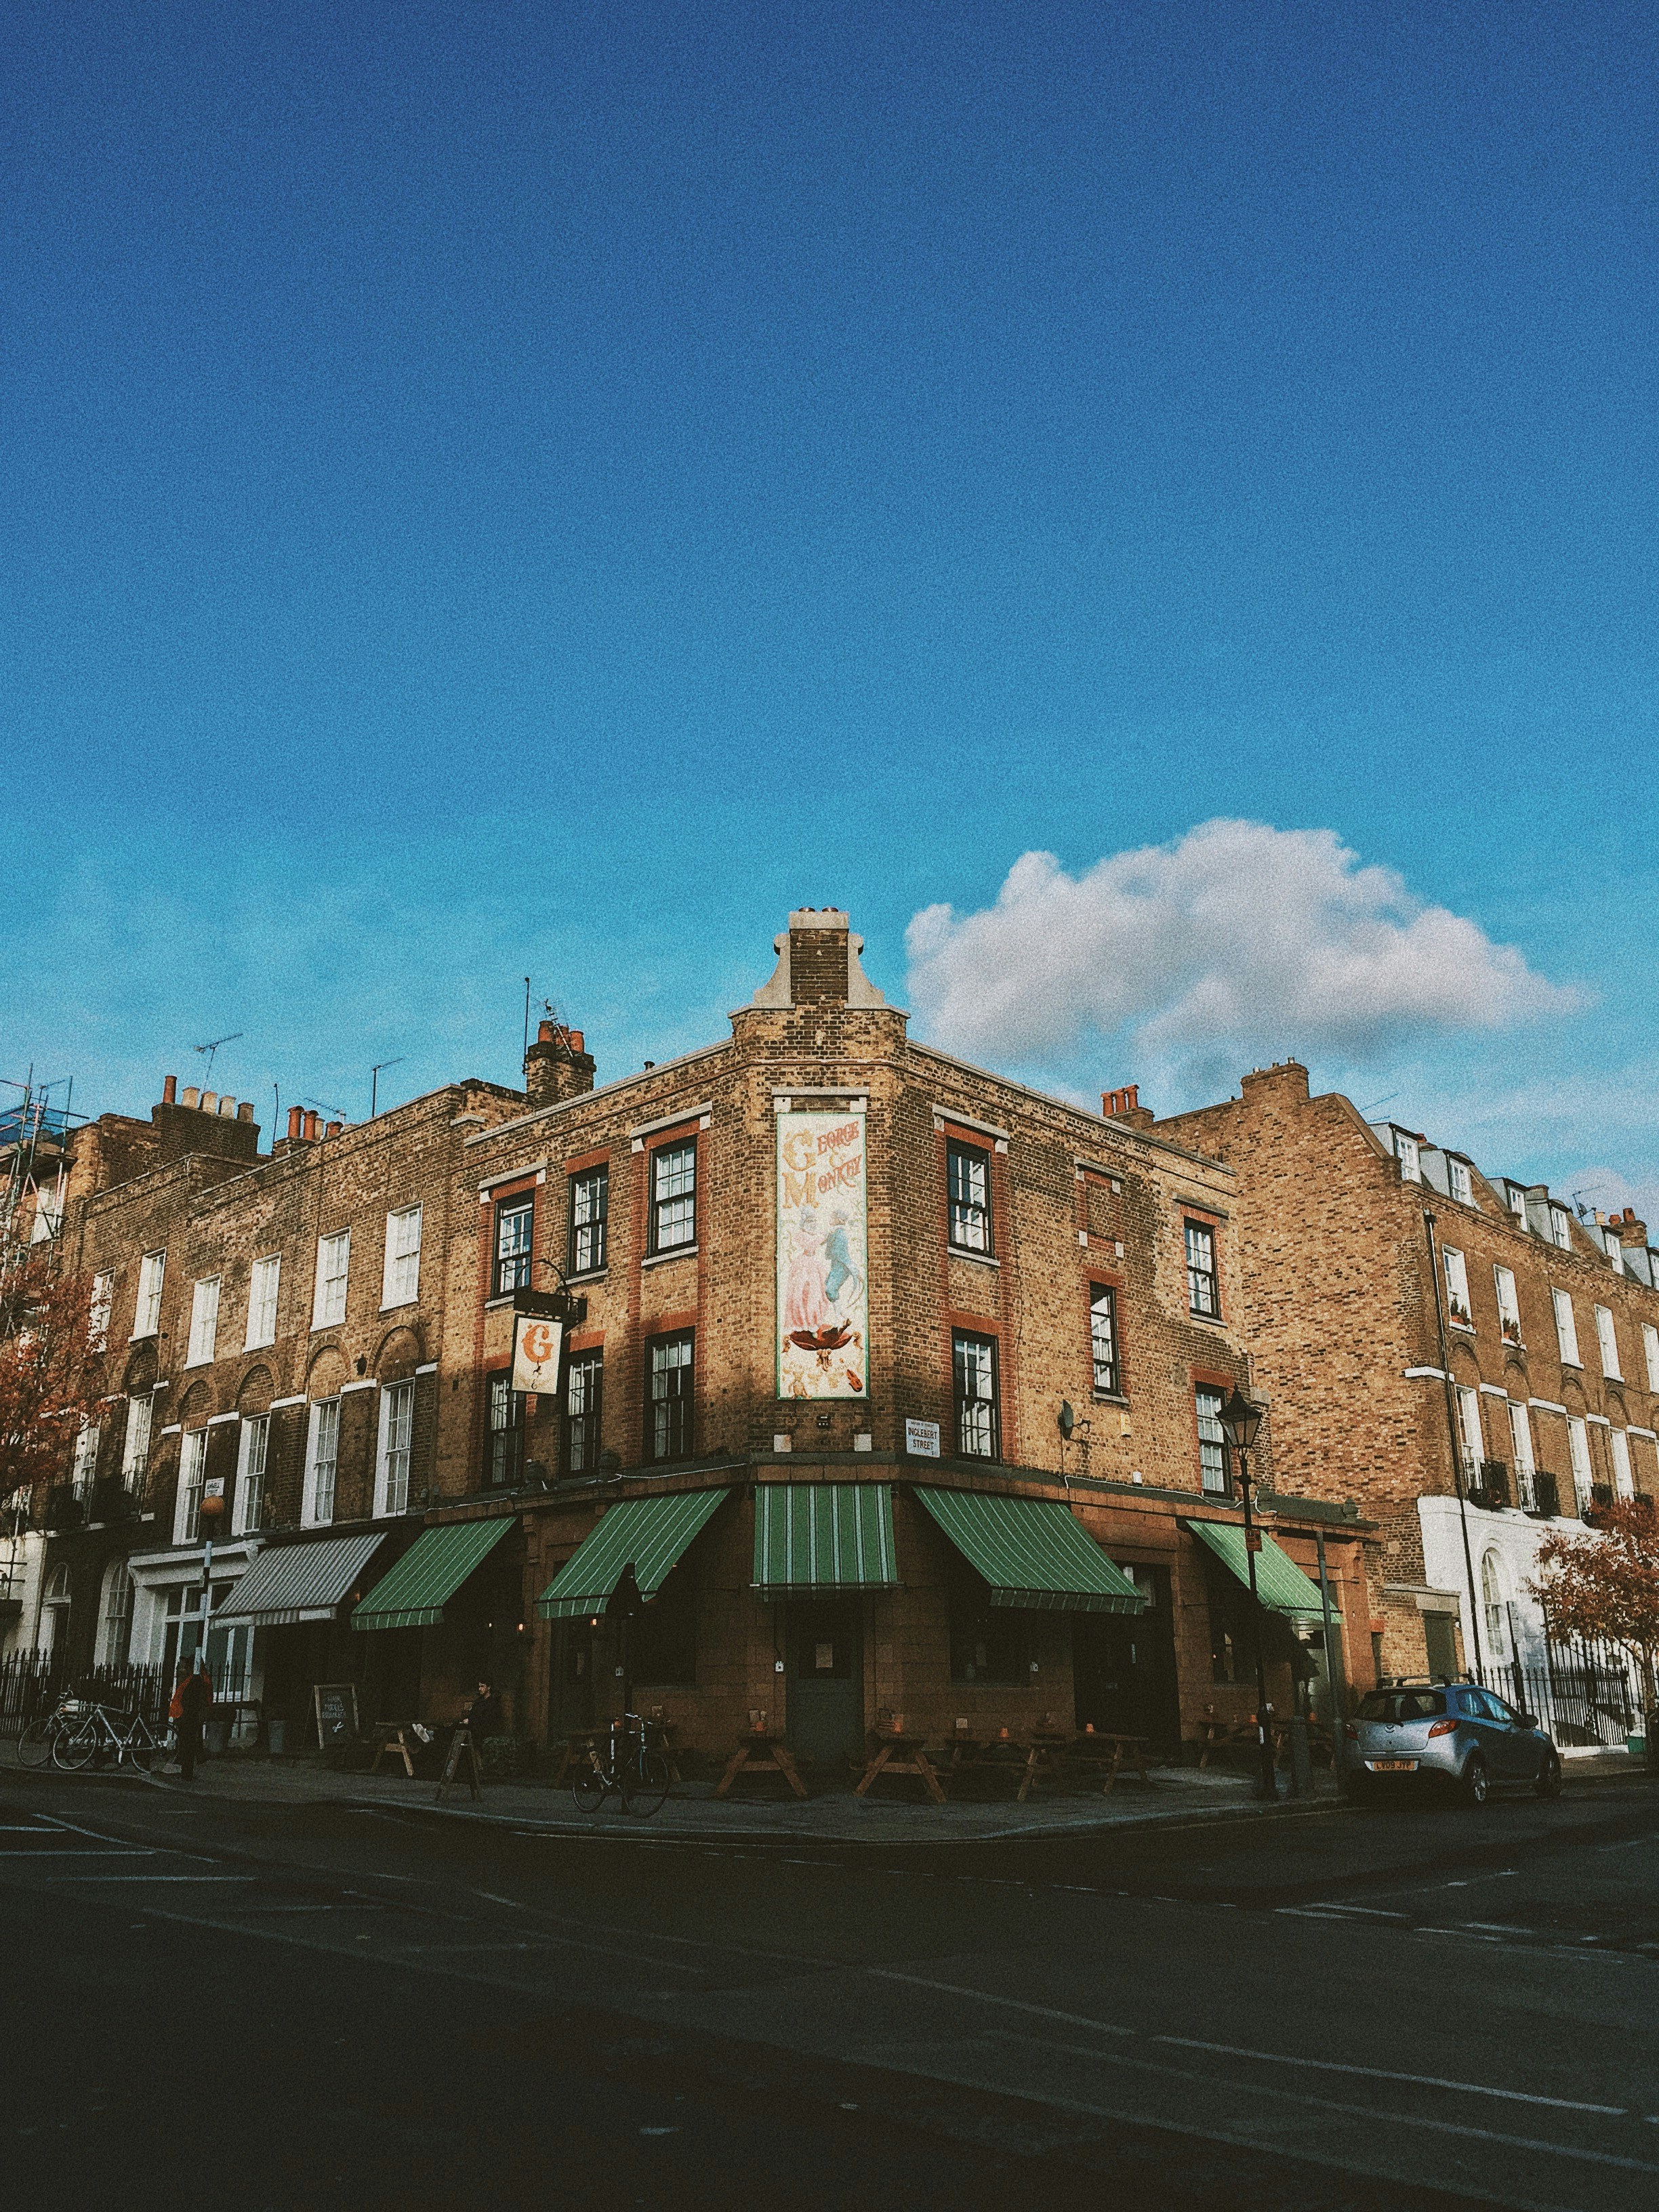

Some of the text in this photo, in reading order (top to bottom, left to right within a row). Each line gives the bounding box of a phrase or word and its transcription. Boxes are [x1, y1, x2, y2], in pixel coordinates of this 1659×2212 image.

[782, 1120, 859, 1171] GEORGE
[781, 1153, 863, 1208] MONKEY
[521, 1324, 554, 1363] G
[908, 1427, 937, 1439] INGLEBERT
[913, 1439, 934, 1450] STREET
